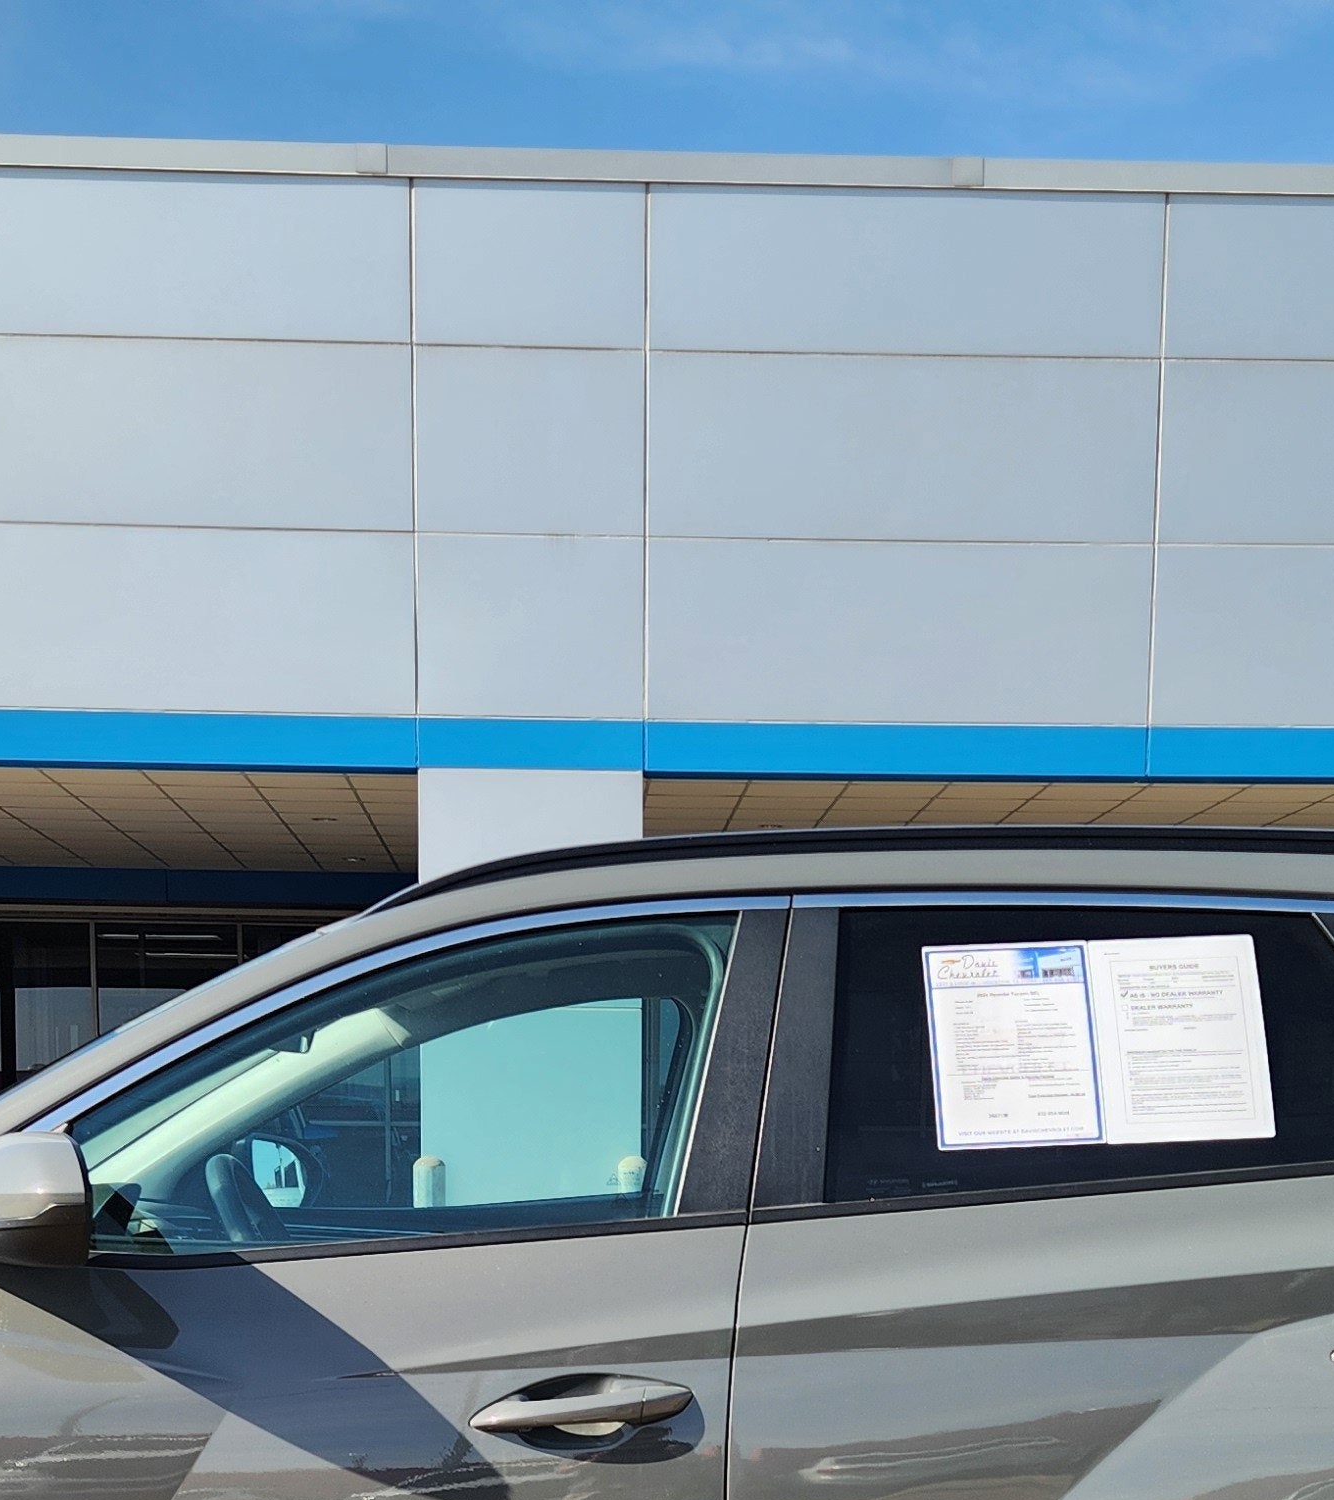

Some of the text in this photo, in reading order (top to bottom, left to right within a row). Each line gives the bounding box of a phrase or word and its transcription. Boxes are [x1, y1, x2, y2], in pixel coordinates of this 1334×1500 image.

[961, 955, 999, 969] Davis
[937, 966, 1002, 980] Chevrolet
[1188, 989, 1224, 997] WARRANTY
